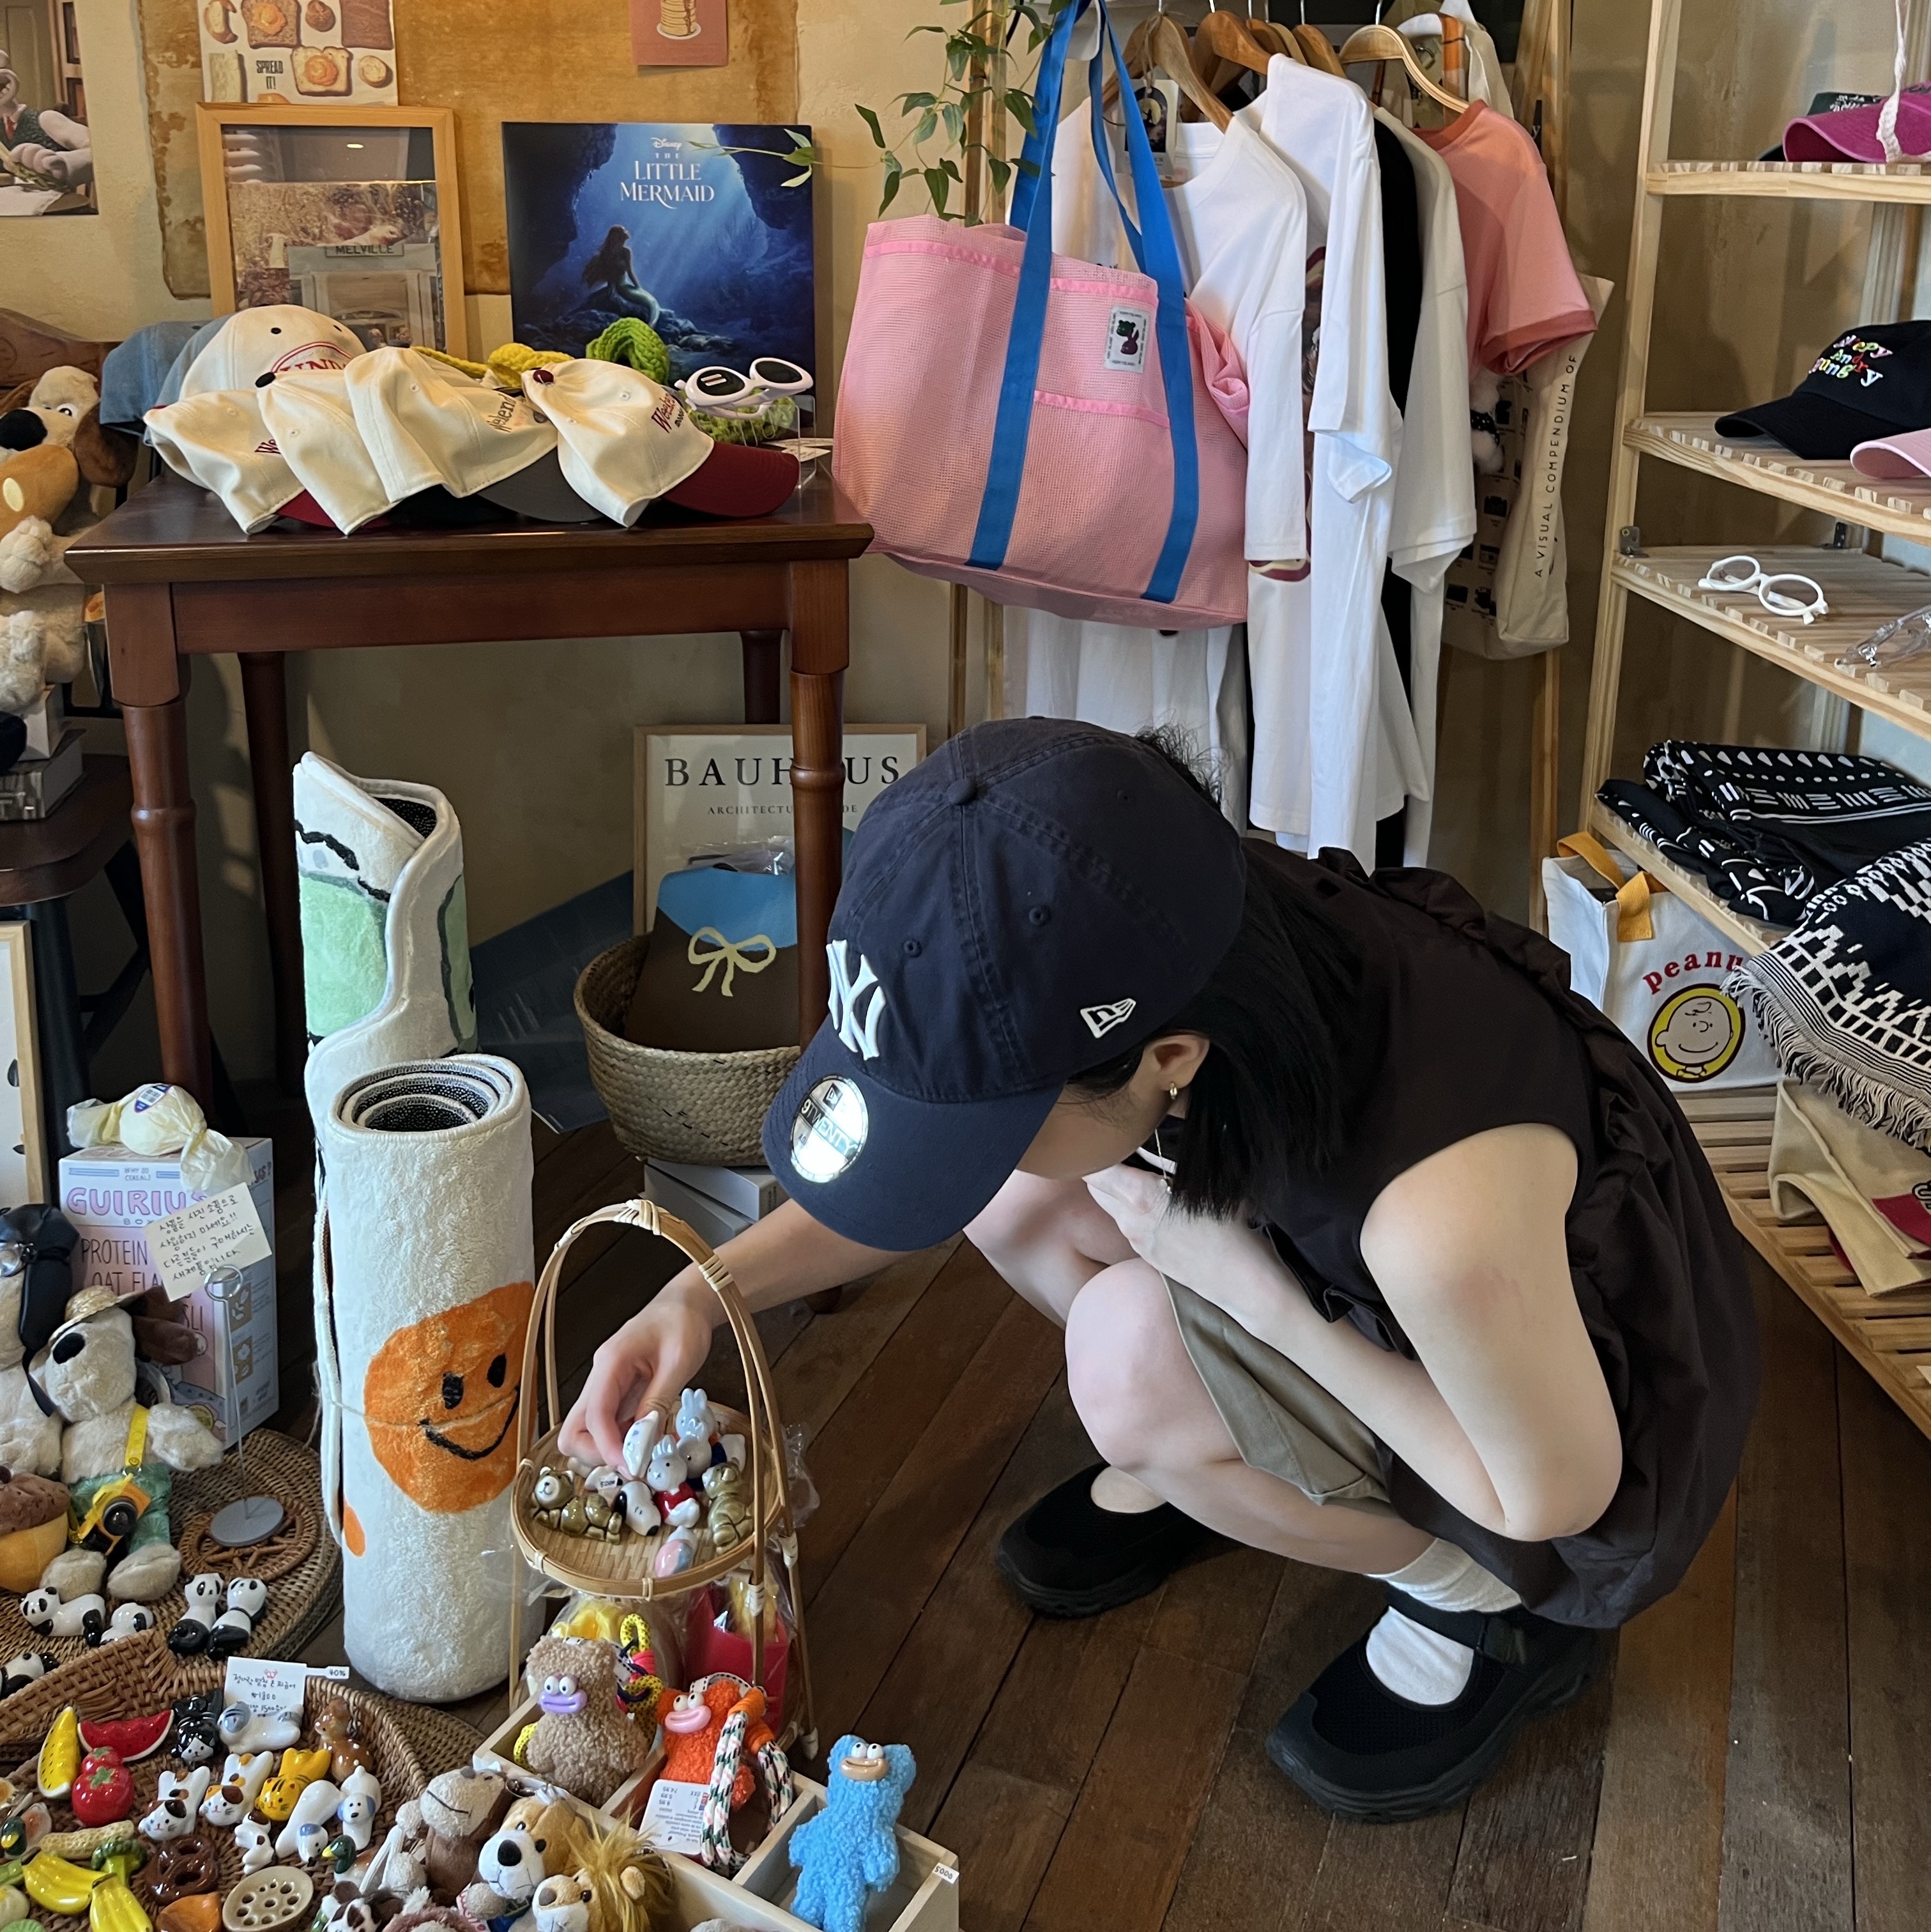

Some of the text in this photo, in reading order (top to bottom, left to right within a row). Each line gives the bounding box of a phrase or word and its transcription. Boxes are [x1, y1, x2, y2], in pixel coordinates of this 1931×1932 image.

[256, 60, 283, 74] SPREAD
[266, 76, 276, 89] IT!
[634, 160, 701, 180] LITTLE
[620, 181, 715, 210] MERMAID
[335, 245, 394, 254] MELVILLE
[1534, 355, 1577, 578] A VISUAL COMPENDIUM OF
[665, 756, 899, 786] BAUHUS
[707, 804, 793, 815] ARCHITECTU
[1643, 951, 1744, 995] peanu
[160, 1195, 238, 1234] 상품은 사진 소품으로
[160, 1230, 196, 1251] 사용하지
[210, 1223, 255, 1249] 구매하시는
[80, 1238, 148, 1266] PROTEIN
[92, 1272, 123, 1296] OAT
[935, 1866, 953, 1880] 5000
